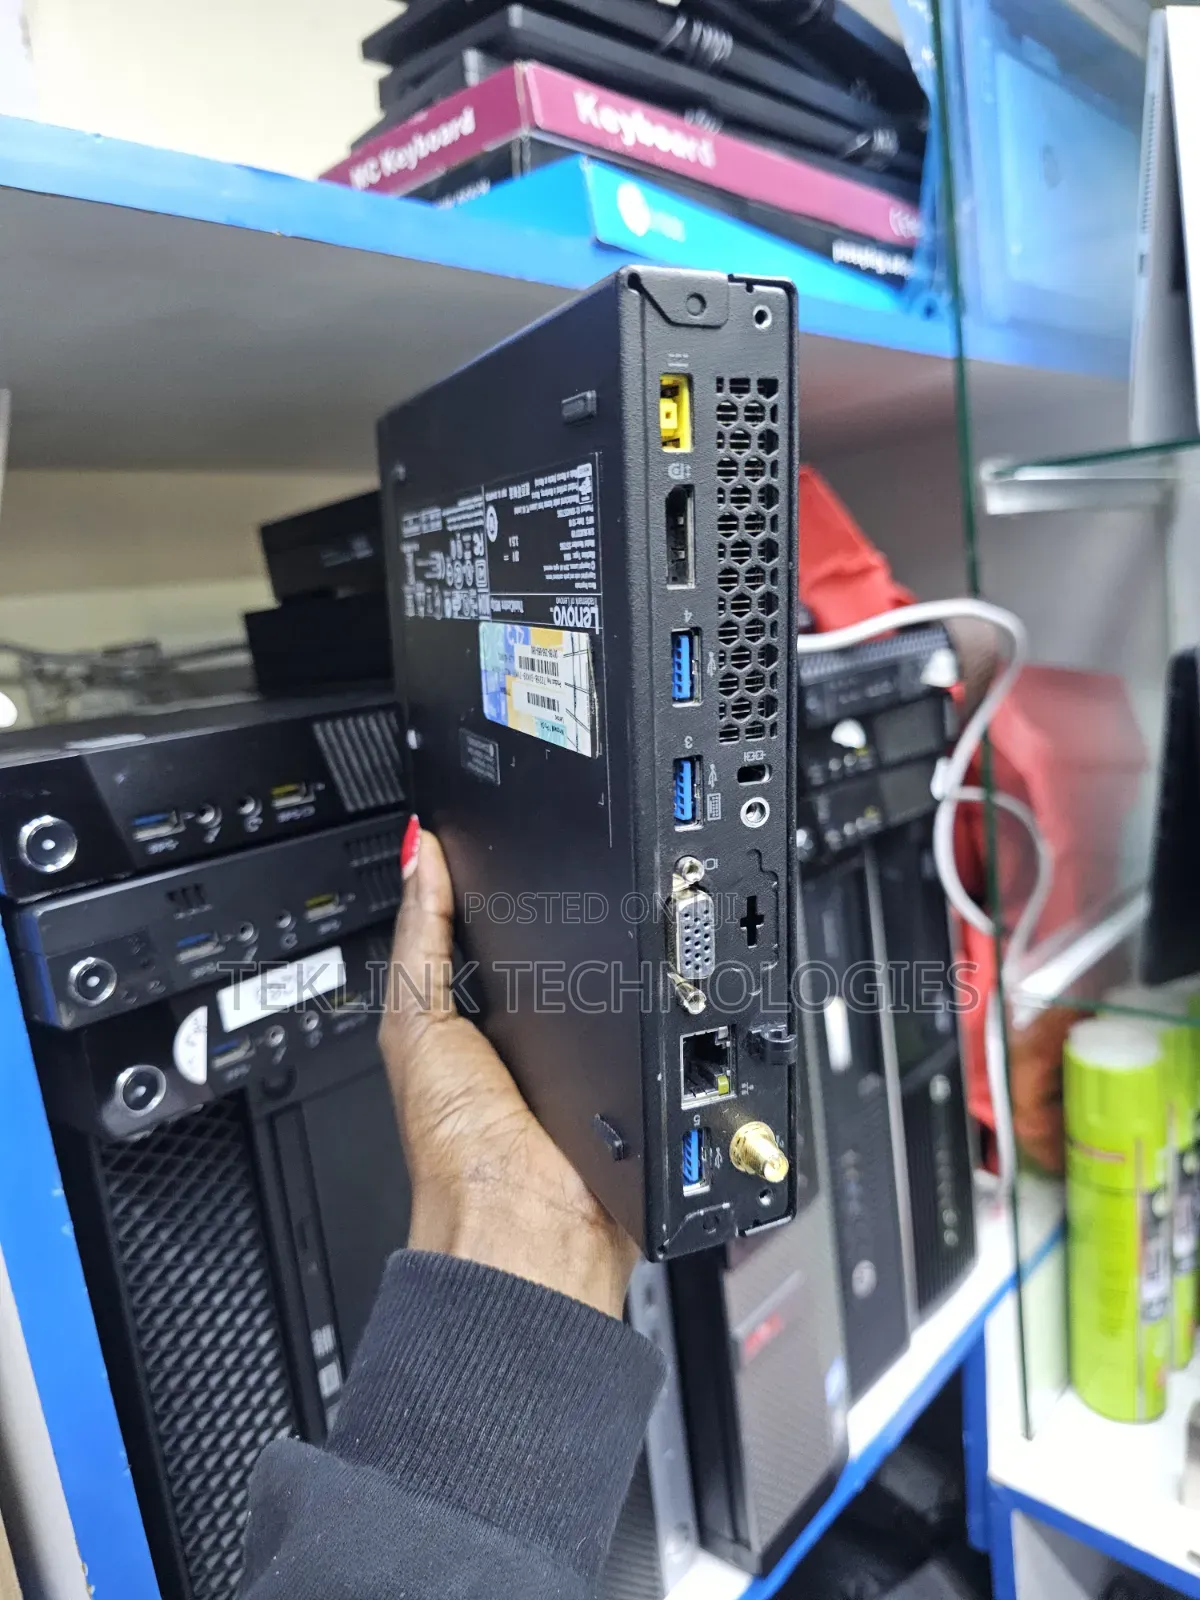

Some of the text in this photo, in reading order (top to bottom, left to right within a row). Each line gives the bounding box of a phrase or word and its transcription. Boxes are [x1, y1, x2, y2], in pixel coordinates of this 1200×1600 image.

[572, 87, 717, 170] Keyboard
[378, 105, 477, 178] Keyboard
[552, 605, 600, 635] Lenovo
[683, 607, 693, 623] 4
[684, 735, 693, 750] 3
[693, 1114, 701, 1127] 5
